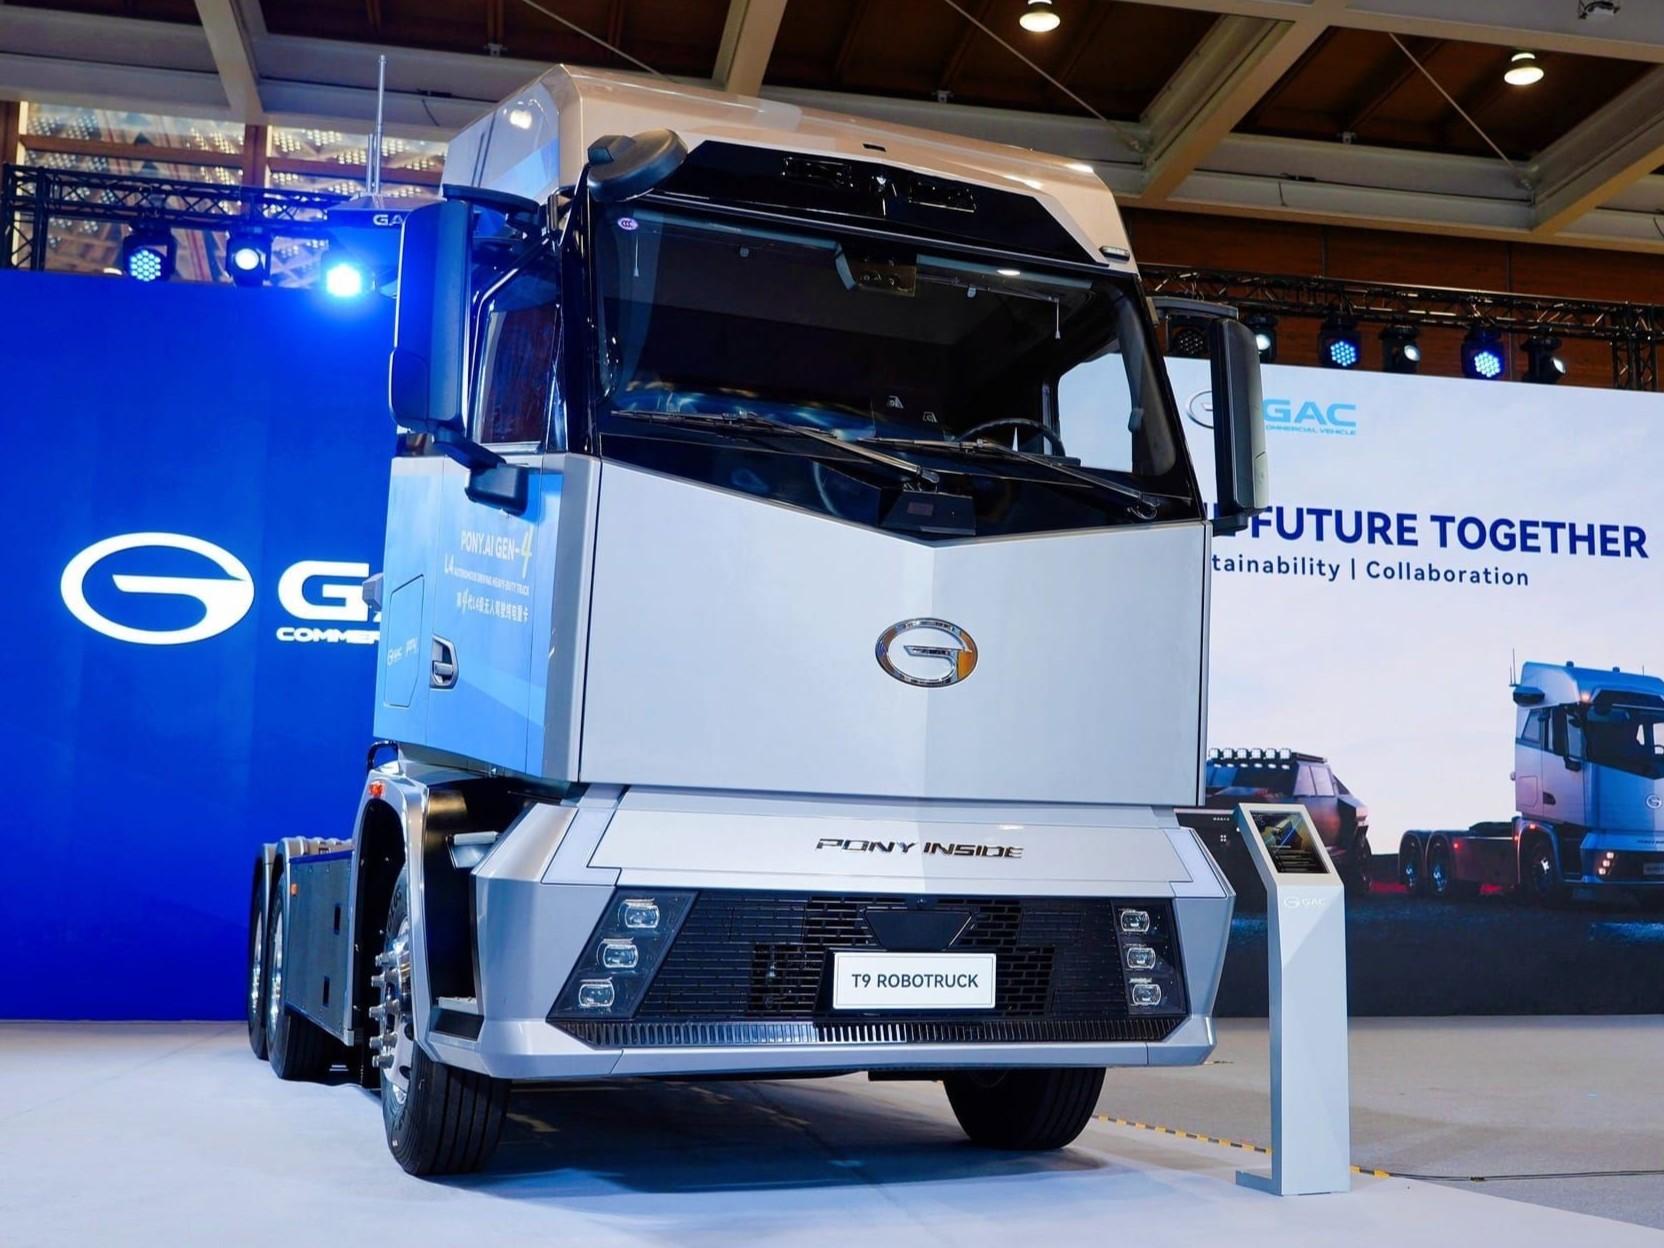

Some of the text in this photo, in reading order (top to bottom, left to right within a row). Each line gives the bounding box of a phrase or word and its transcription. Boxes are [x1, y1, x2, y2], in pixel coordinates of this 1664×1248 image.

[1263, 398, 1357, 428] GAC
[1320, 427, 1356, 436] VEHICLE
[1250, 504, 1419, 547] FUTURE
[1430, 513, 1650, 559] TOGETHER
[1366, 559, 1530, 586] Collaboration
[815, 838, 1024, 859] PONY INSIDE
[851, 973, 979, 989] T9 ROBOTRUCK
